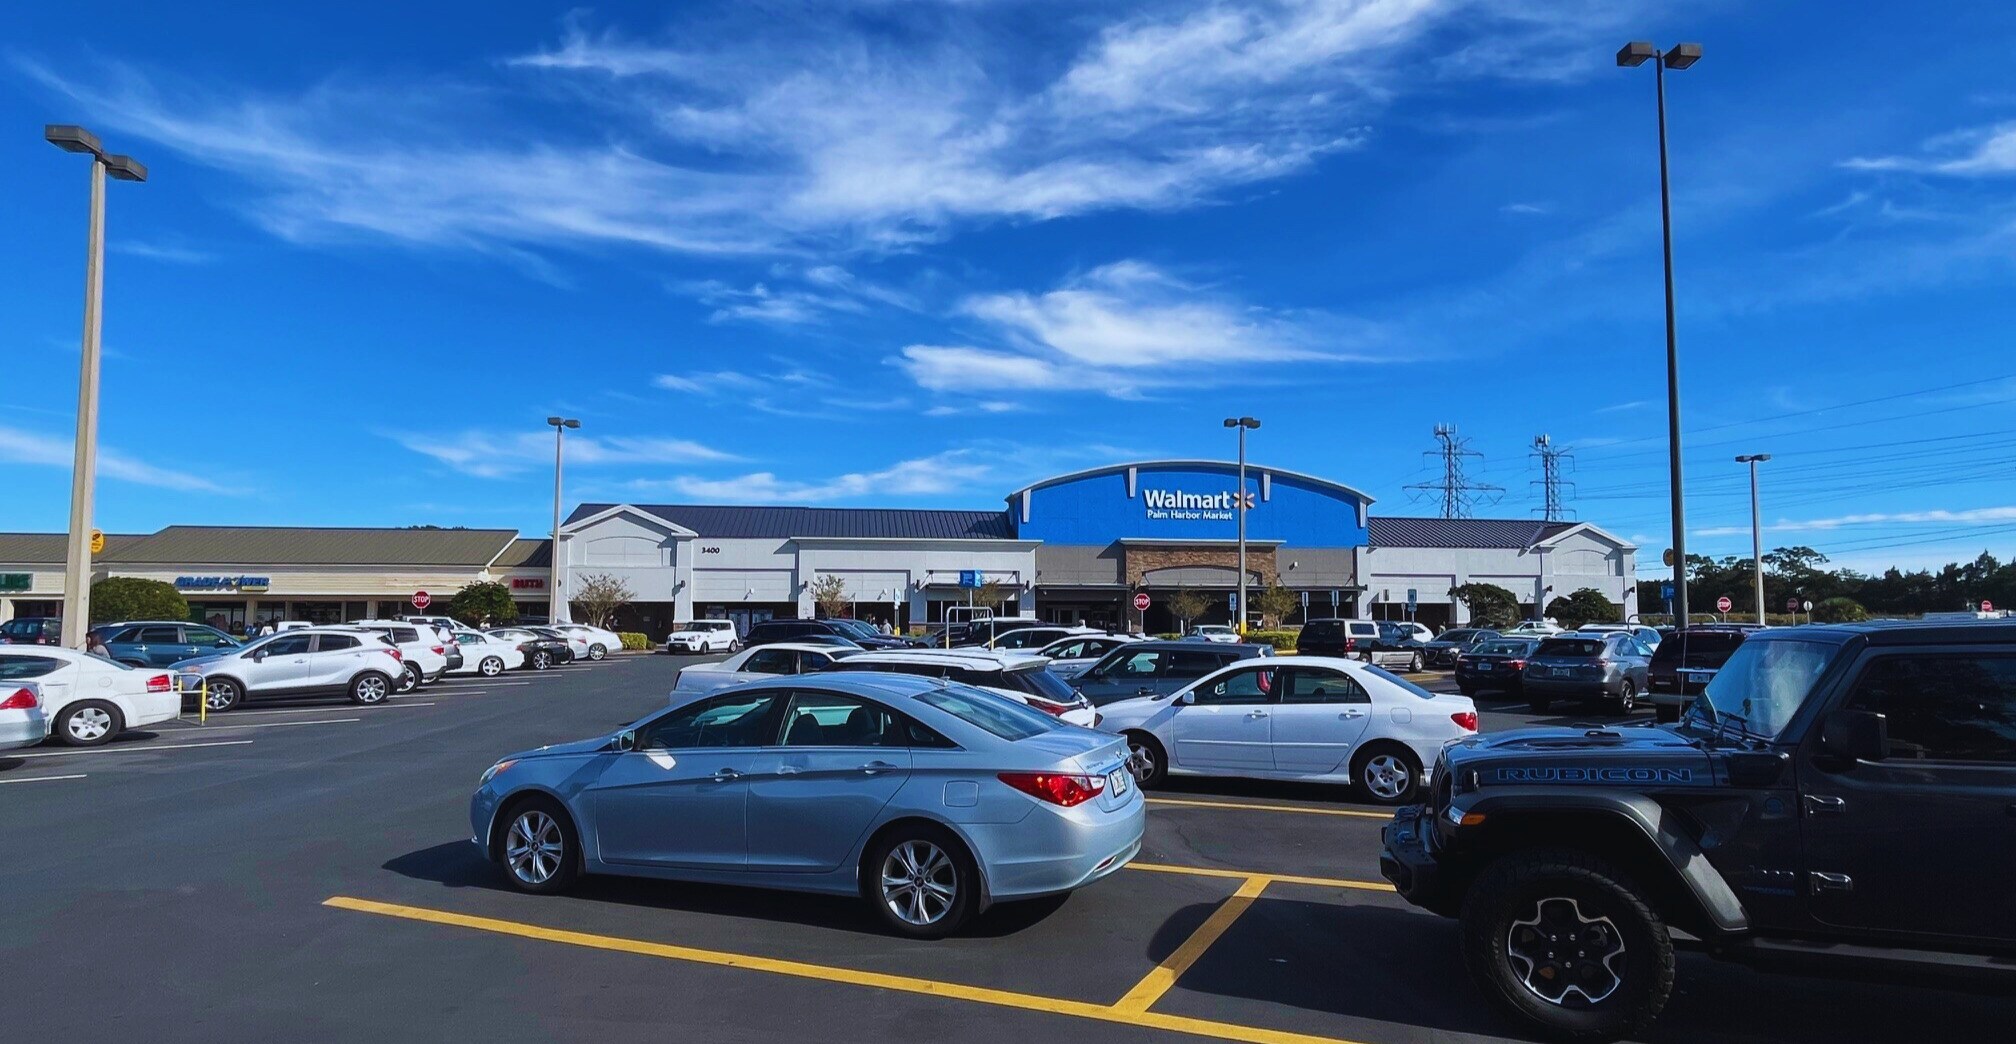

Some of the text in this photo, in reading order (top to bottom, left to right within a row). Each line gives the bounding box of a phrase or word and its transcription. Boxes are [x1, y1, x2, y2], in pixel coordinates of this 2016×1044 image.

[1144, 489, 1230, 509] Walmart
[1147, 510, 1232, 520] Palm Harbor Market
[1497, 768, 1692, 782] RUBICON
